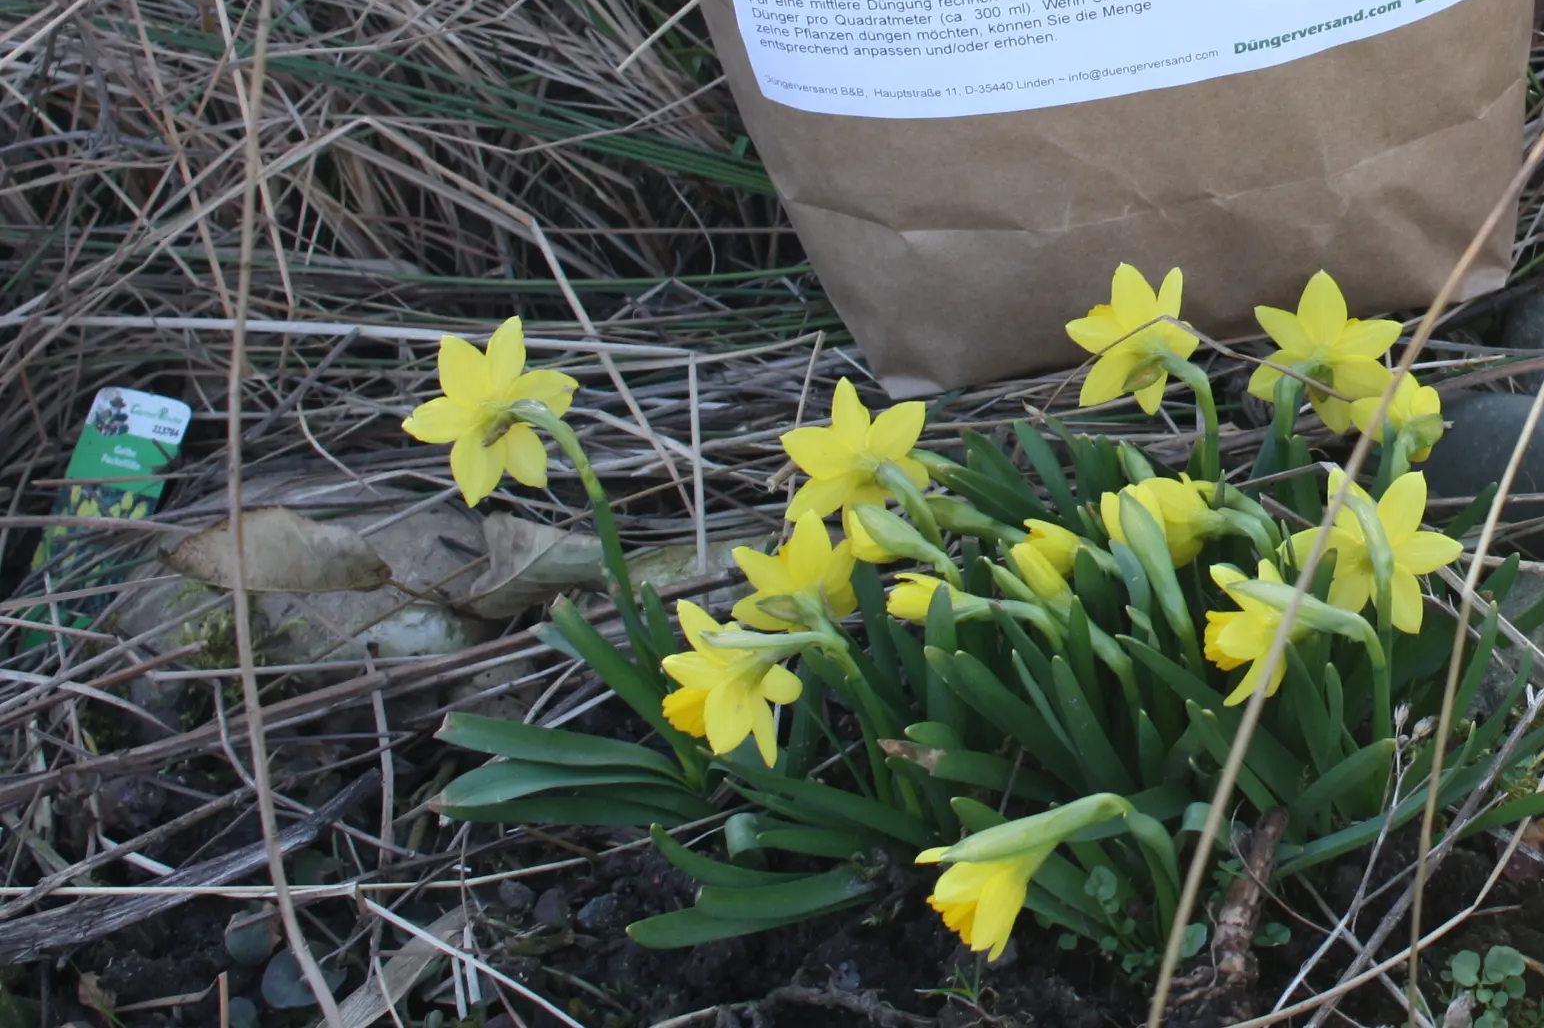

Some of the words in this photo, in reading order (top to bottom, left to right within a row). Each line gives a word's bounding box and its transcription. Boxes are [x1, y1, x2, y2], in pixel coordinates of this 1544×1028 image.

[751, 6, 800, 25] Dünger
[805, 15, 828, 26] pro
[834, 13, 932, 26] Quadratmeter
[939, 12, 966, 26] (ca.
[973, 6, 1003, 20] 300
[1008, 1, 1035, 16] ml).
[866, 0, 932, 13] Düngung
[755, 23, 790, 37] zelne
[793, 26, 854, 41] Pflanzen
[856, 29, 912, 44] düngen
[916, 27, 983, 40] möchten,
[987, 18, 1042, 34] können
[1046, 13, 1071, 26] Sie
[1075, 8, 1097, 22] die
[1102, 0, 1152, 18] Menge
[1233, 0, 1402, 55] Düngerversand.com
[759, 38, 849, 56] entsprechend
[852, 46, 921, 59] anpassen
[925, 40, 990, 56] und/oder
[993, 33, 1057, 49] erhöhen.
[873, 88, 942, 100] Hauptstraße
[964, 80, 1014, 95] D-35440
[1015, 77, 1055, 90] Linden
